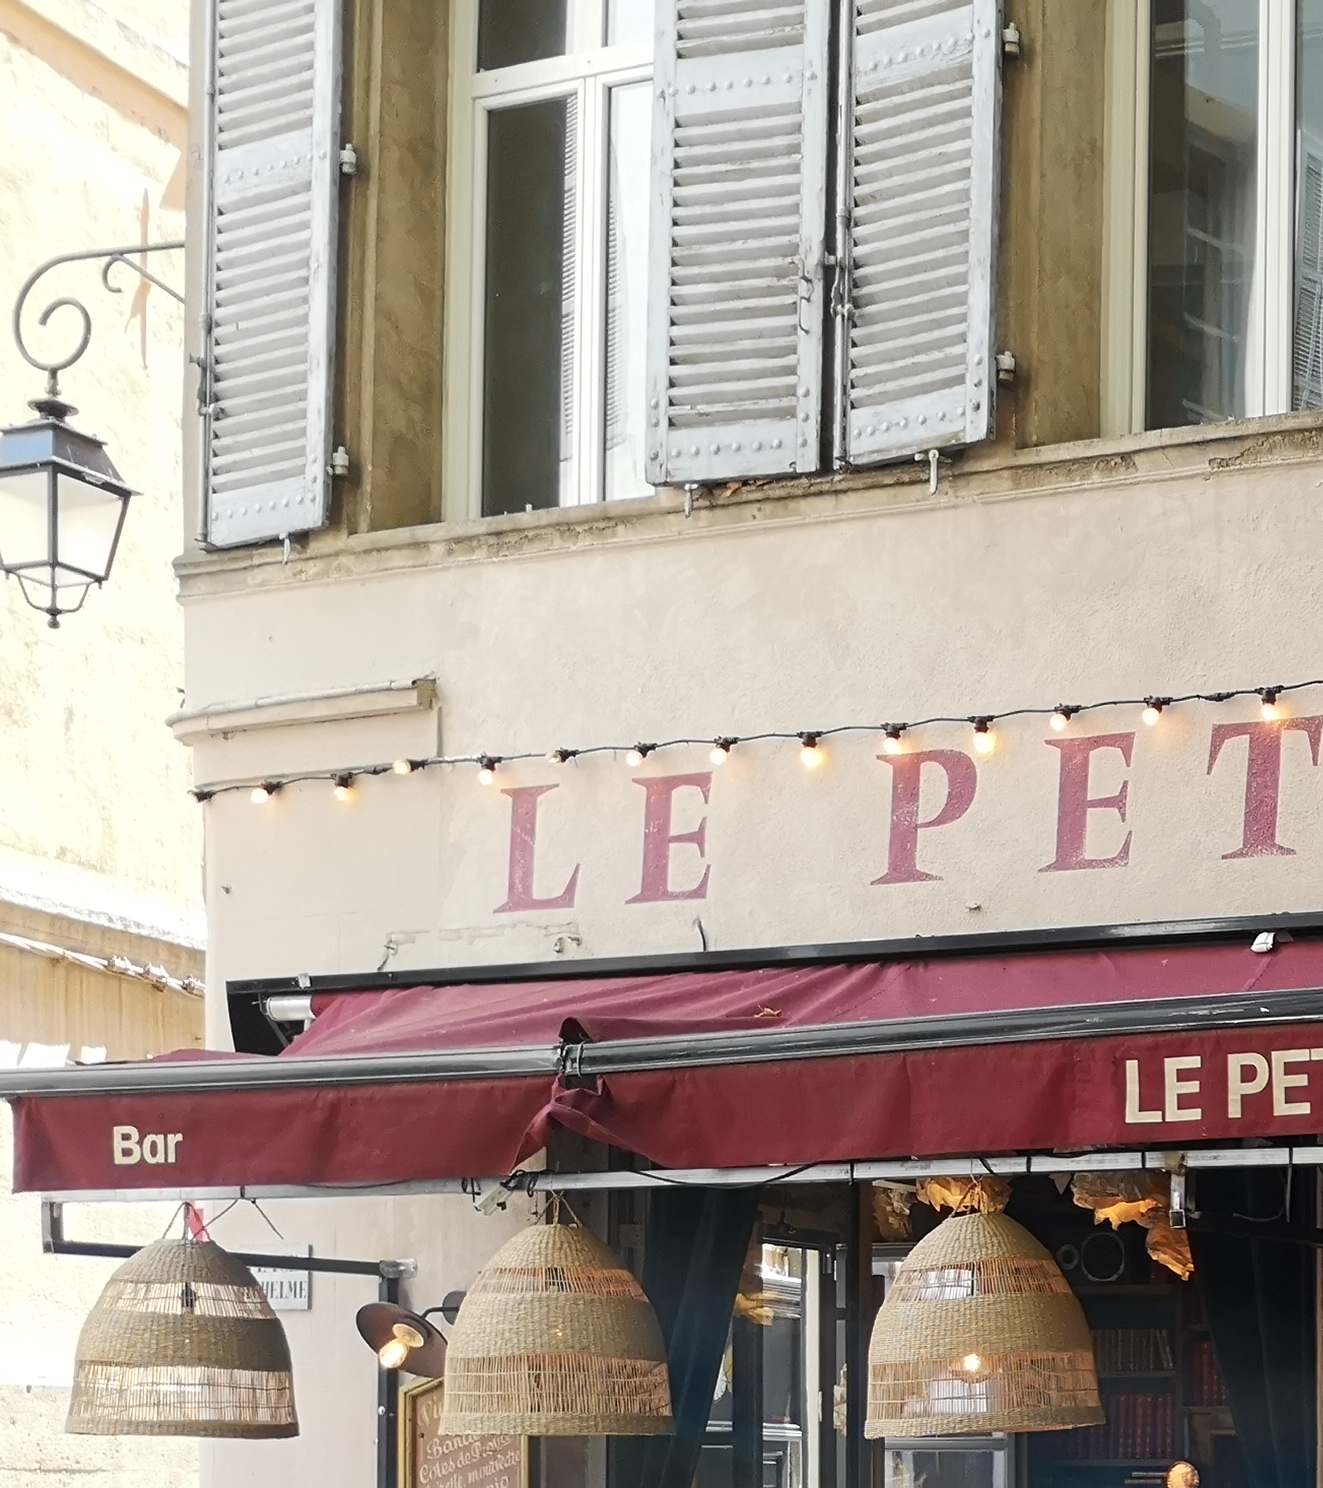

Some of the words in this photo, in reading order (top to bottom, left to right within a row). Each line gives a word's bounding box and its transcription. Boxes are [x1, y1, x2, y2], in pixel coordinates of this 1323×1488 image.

[493, 772, 713, 914] LE
[1125, 1055, 1202, 1124] LE
[112, 1124, 184, 1166] Bar
